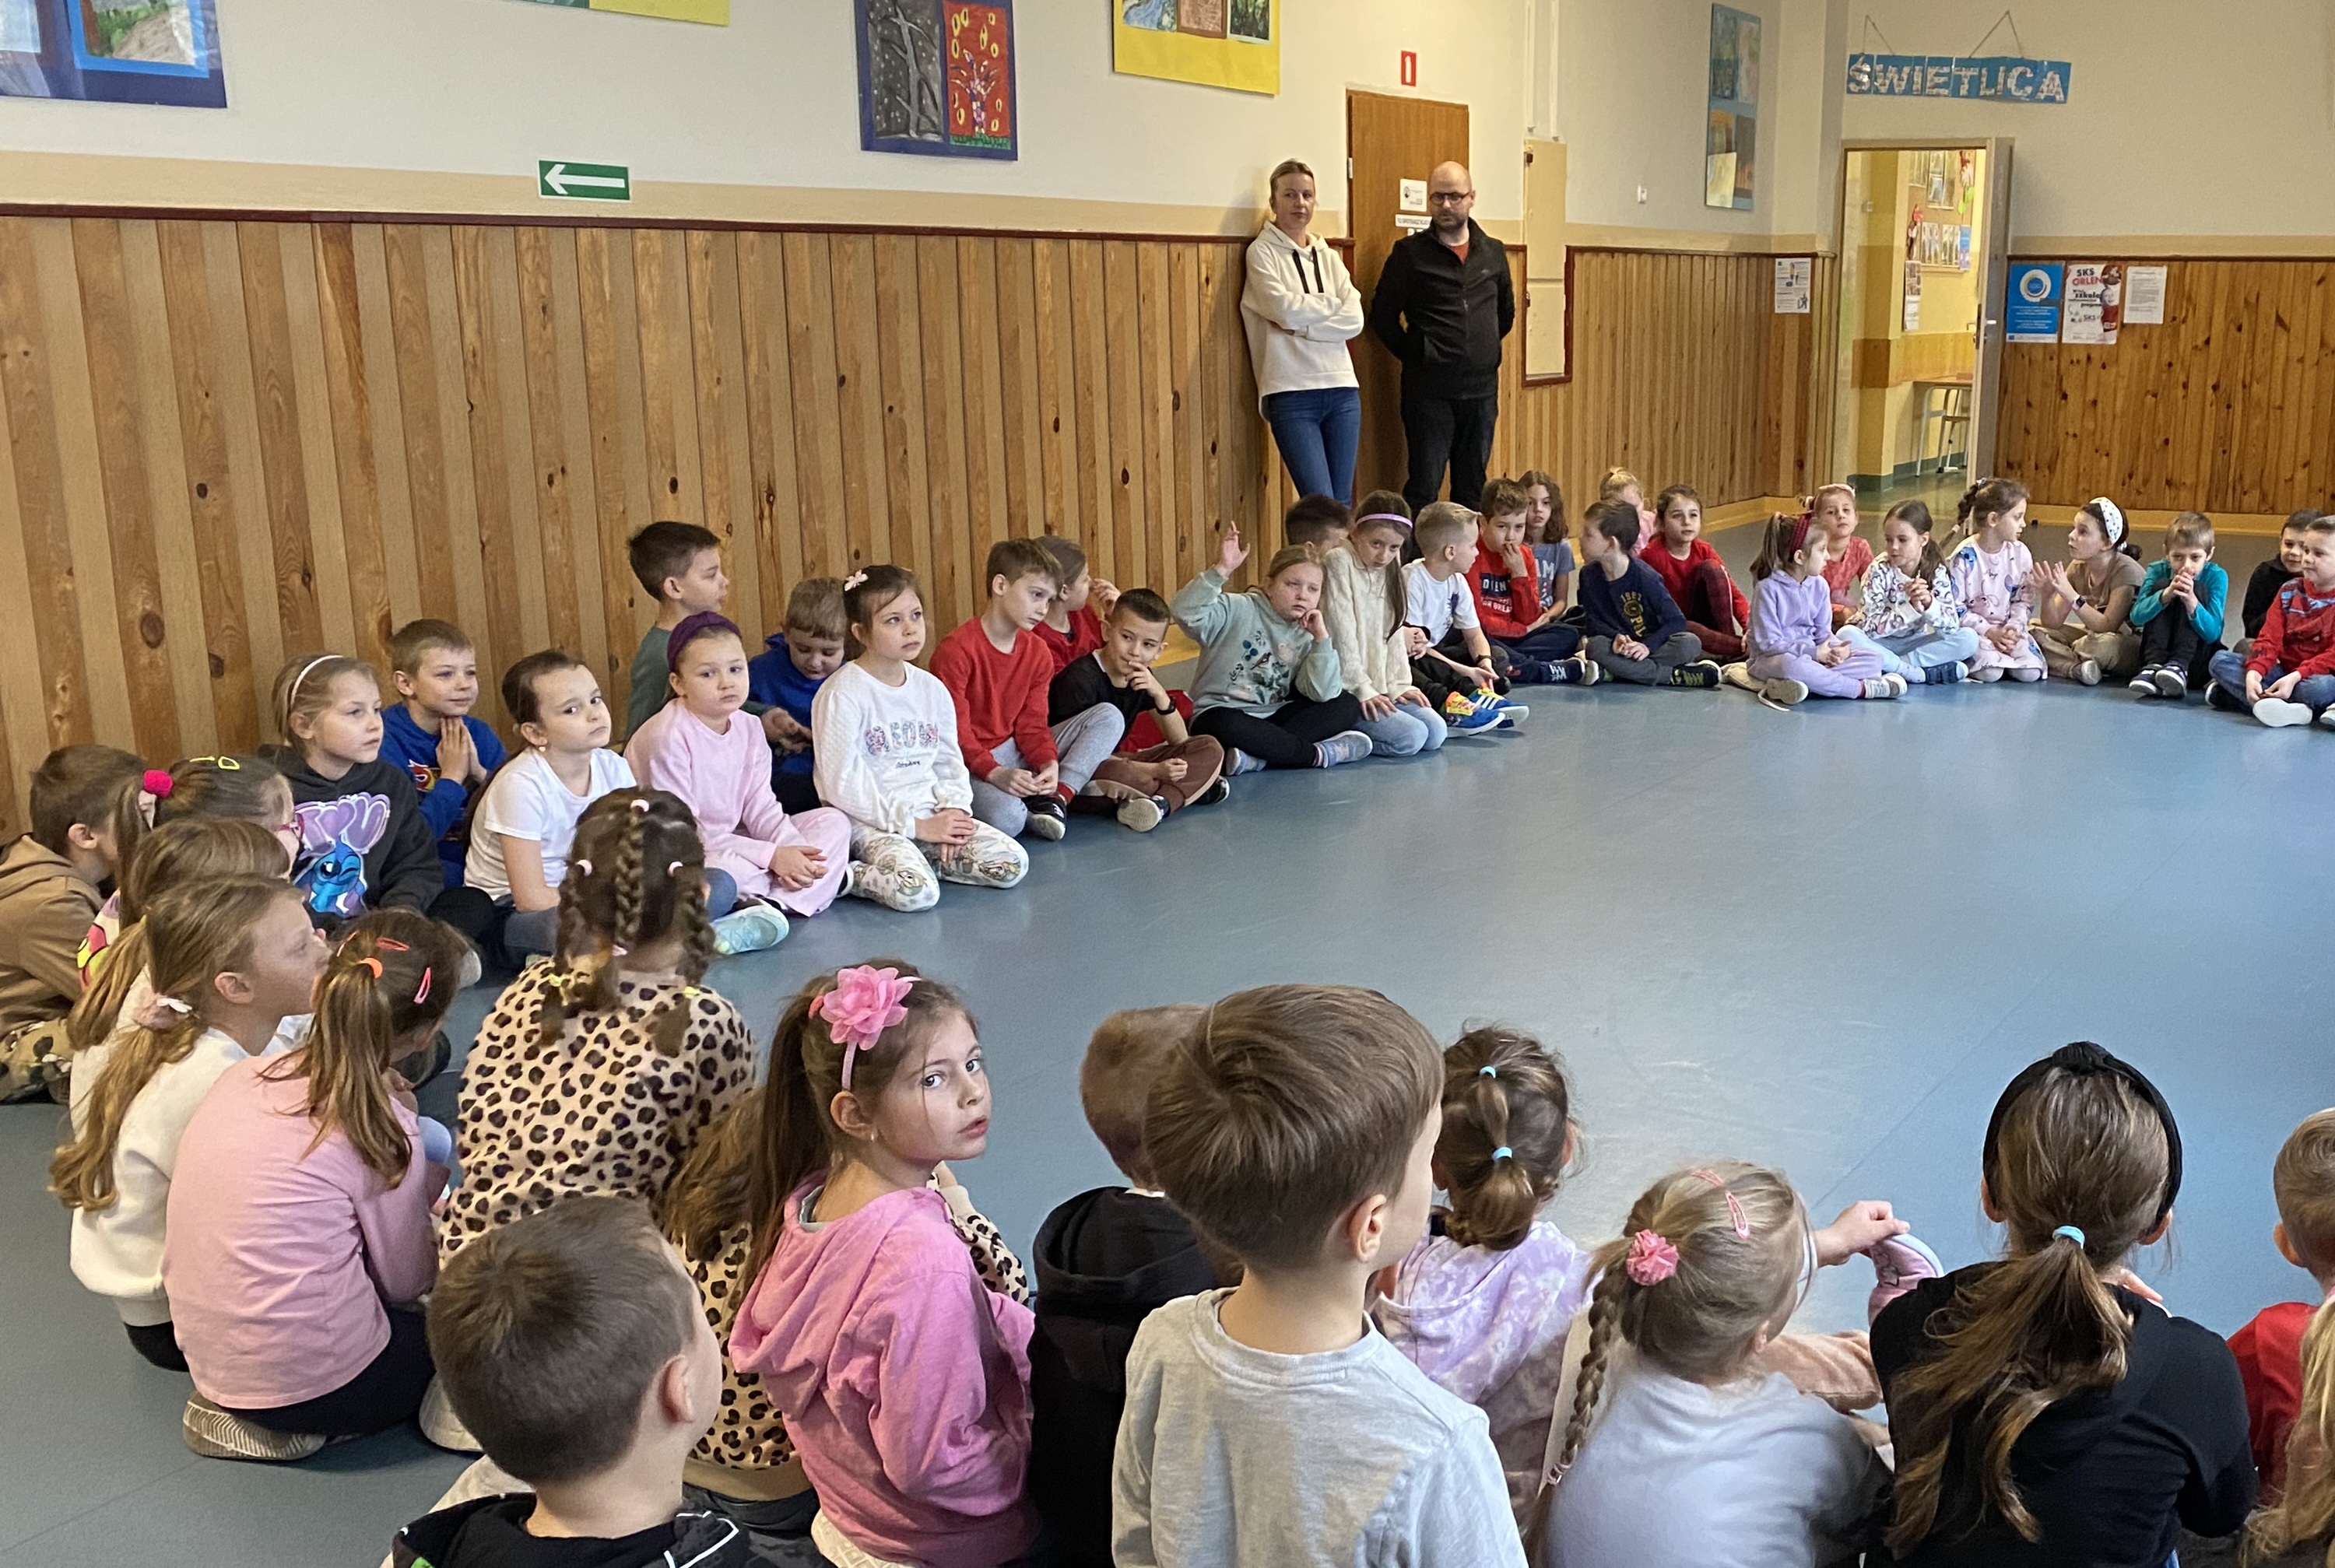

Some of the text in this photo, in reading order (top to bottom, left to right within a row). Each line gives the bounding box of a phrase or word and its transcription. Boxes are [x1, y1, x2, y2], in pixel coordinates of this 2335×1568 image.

[1848, 55, 2065, 102] ŚWIETLICA
[2077, 268, 2095, 277] SKS
[2072, 276, 2104, 286] ORLEN
